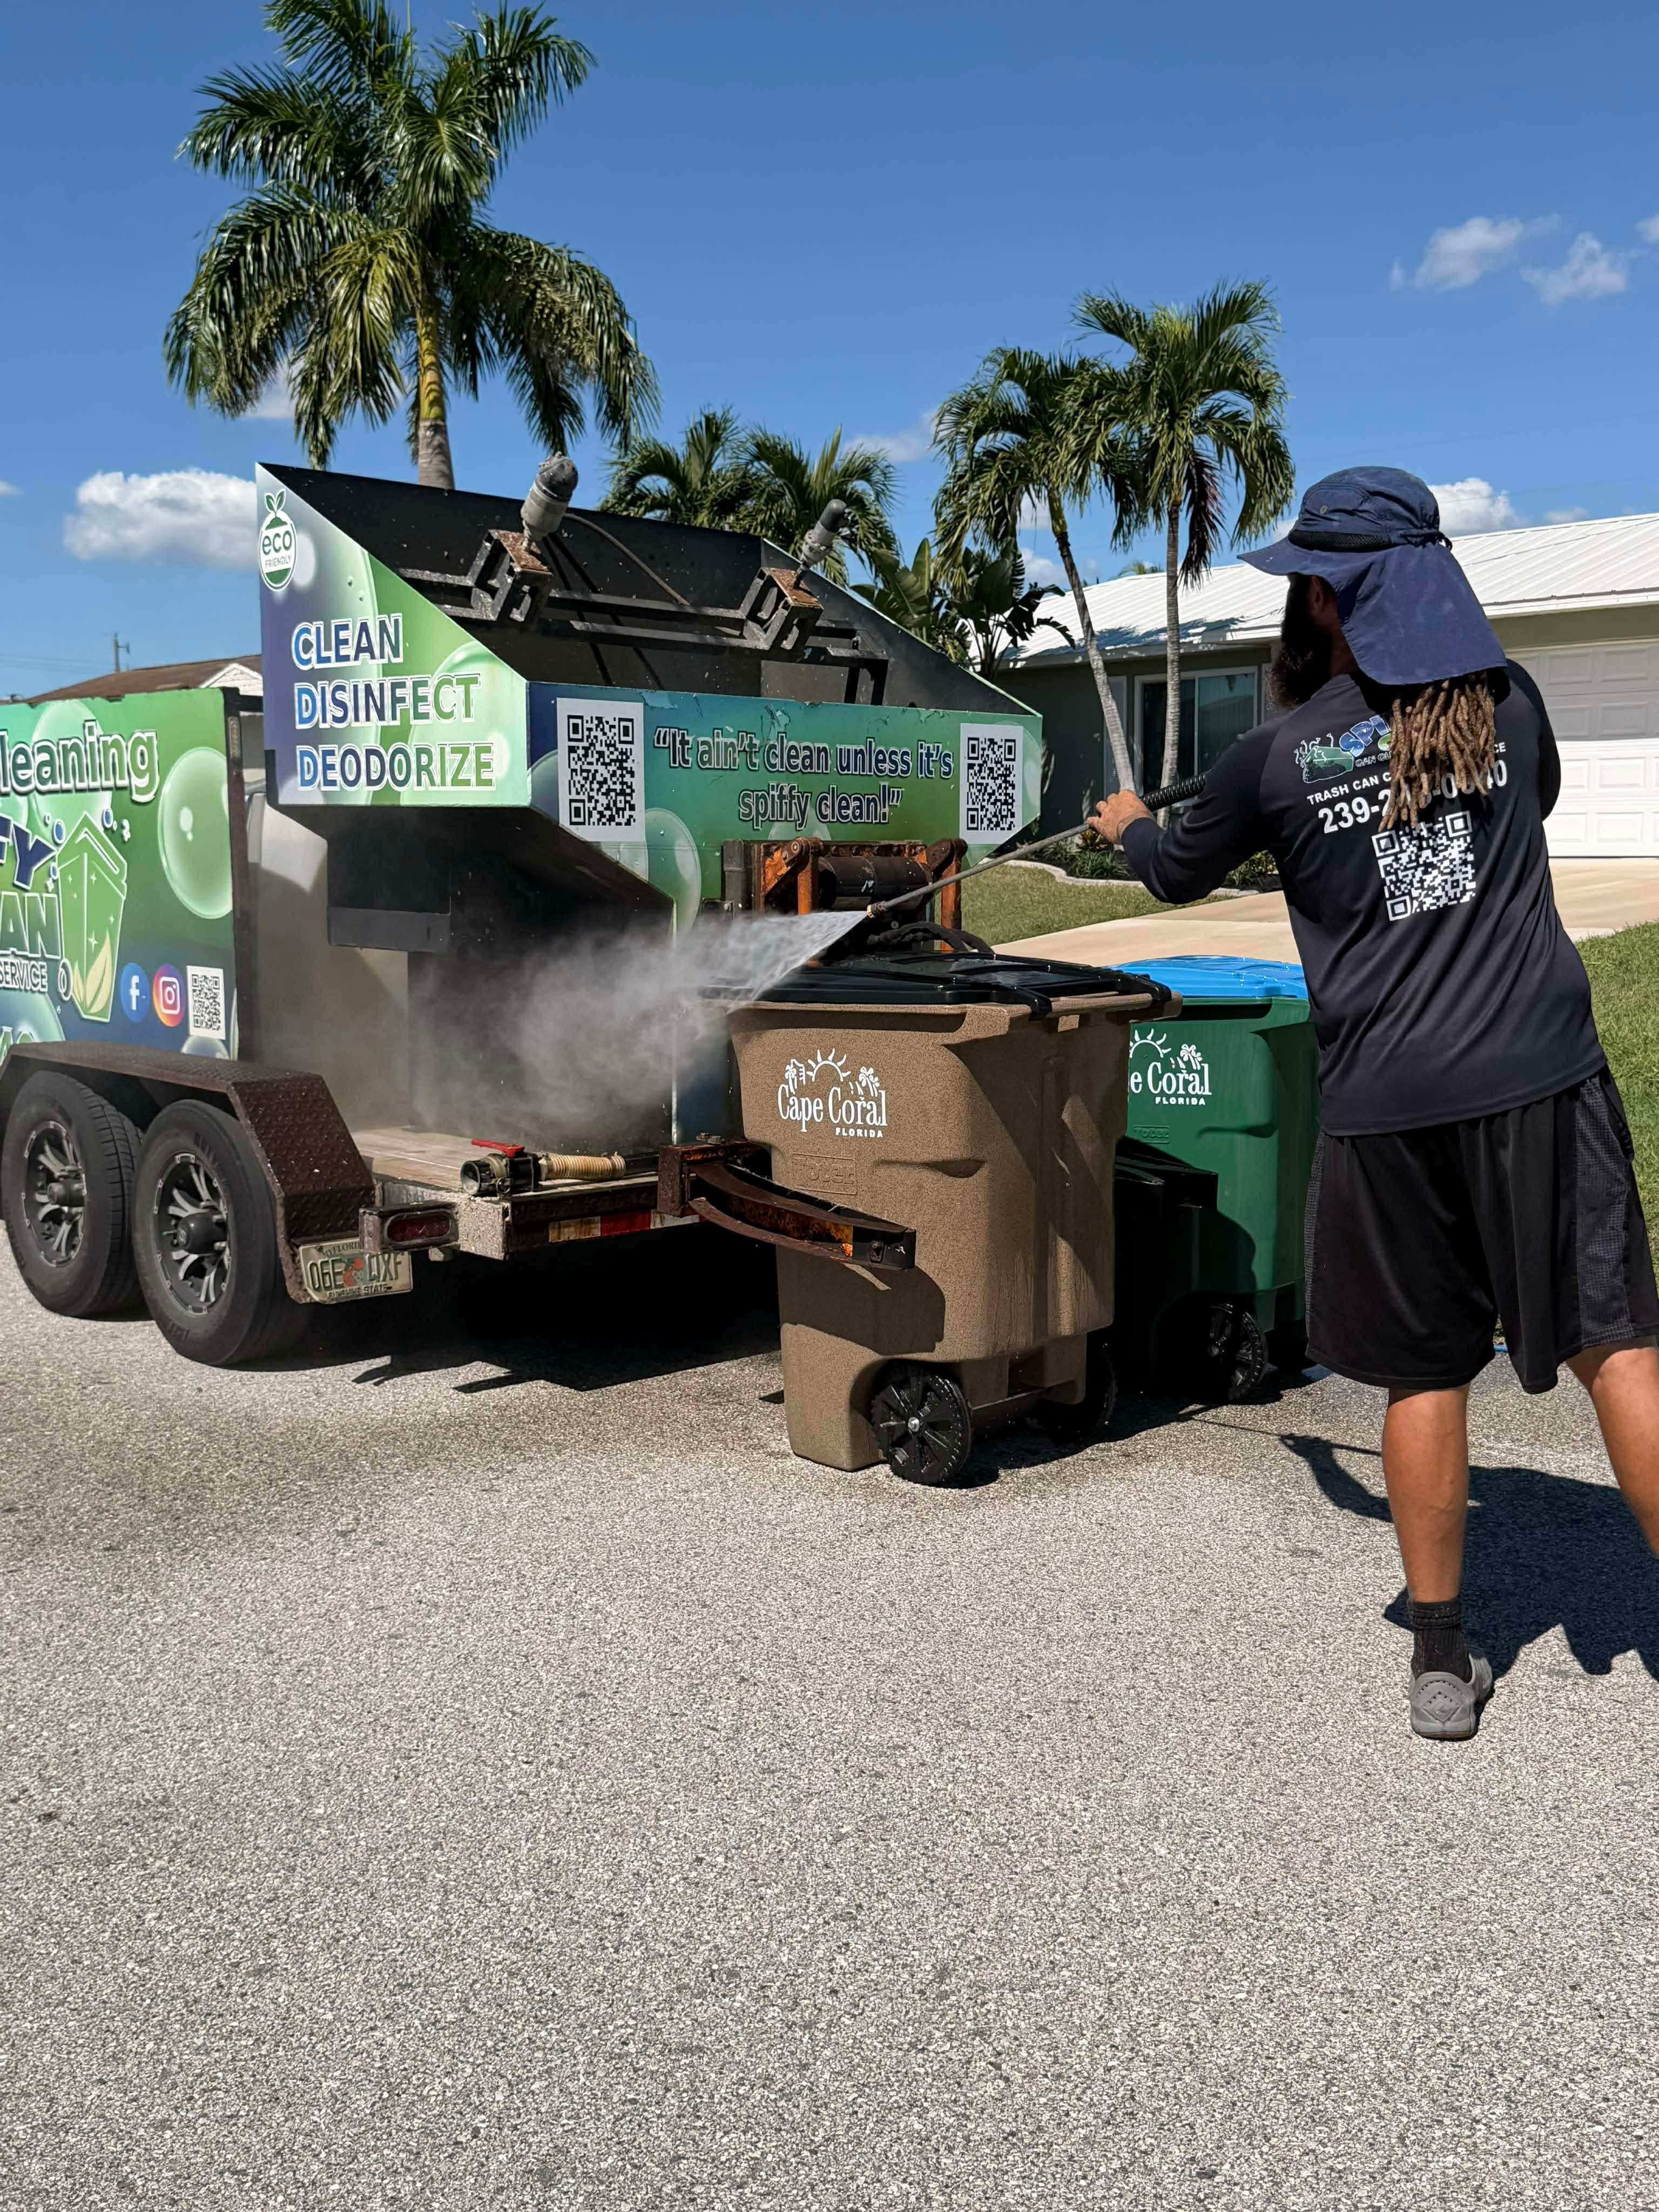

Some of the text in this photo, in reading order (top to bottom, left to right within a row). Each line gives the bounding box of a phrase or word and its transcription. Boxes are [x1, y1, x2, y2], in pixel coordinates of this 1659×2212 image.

[262, 530, 292, 556] eco
[265, 555, 291, 568] FRIENDLY
[292, 612, 403, 670] CLEAN
[294, 671, 480, 729] DISINFECT
[0, 720, 160, 803] leaning
[296, 742, 496, 791] DEODORIZE
[697, 728, 760, 771] ain't
[764, 732, 831, 773] clean
[837, 737, 913, 778] unless
[918, 740, 954, 779] it's
[739, 782, 812, 831] spiffy
[1307, 784, 1350, 805] TRASH
[1353, 775, 1379, 790] CAN
[1147, 1062, 1212, 1095] Coral
[1155, 1097, 1205, 1105] FLORIDA
[778, 1084, 888, 1132] Cape Coral
[835, 1127, 884, 1138] FLORIDA
